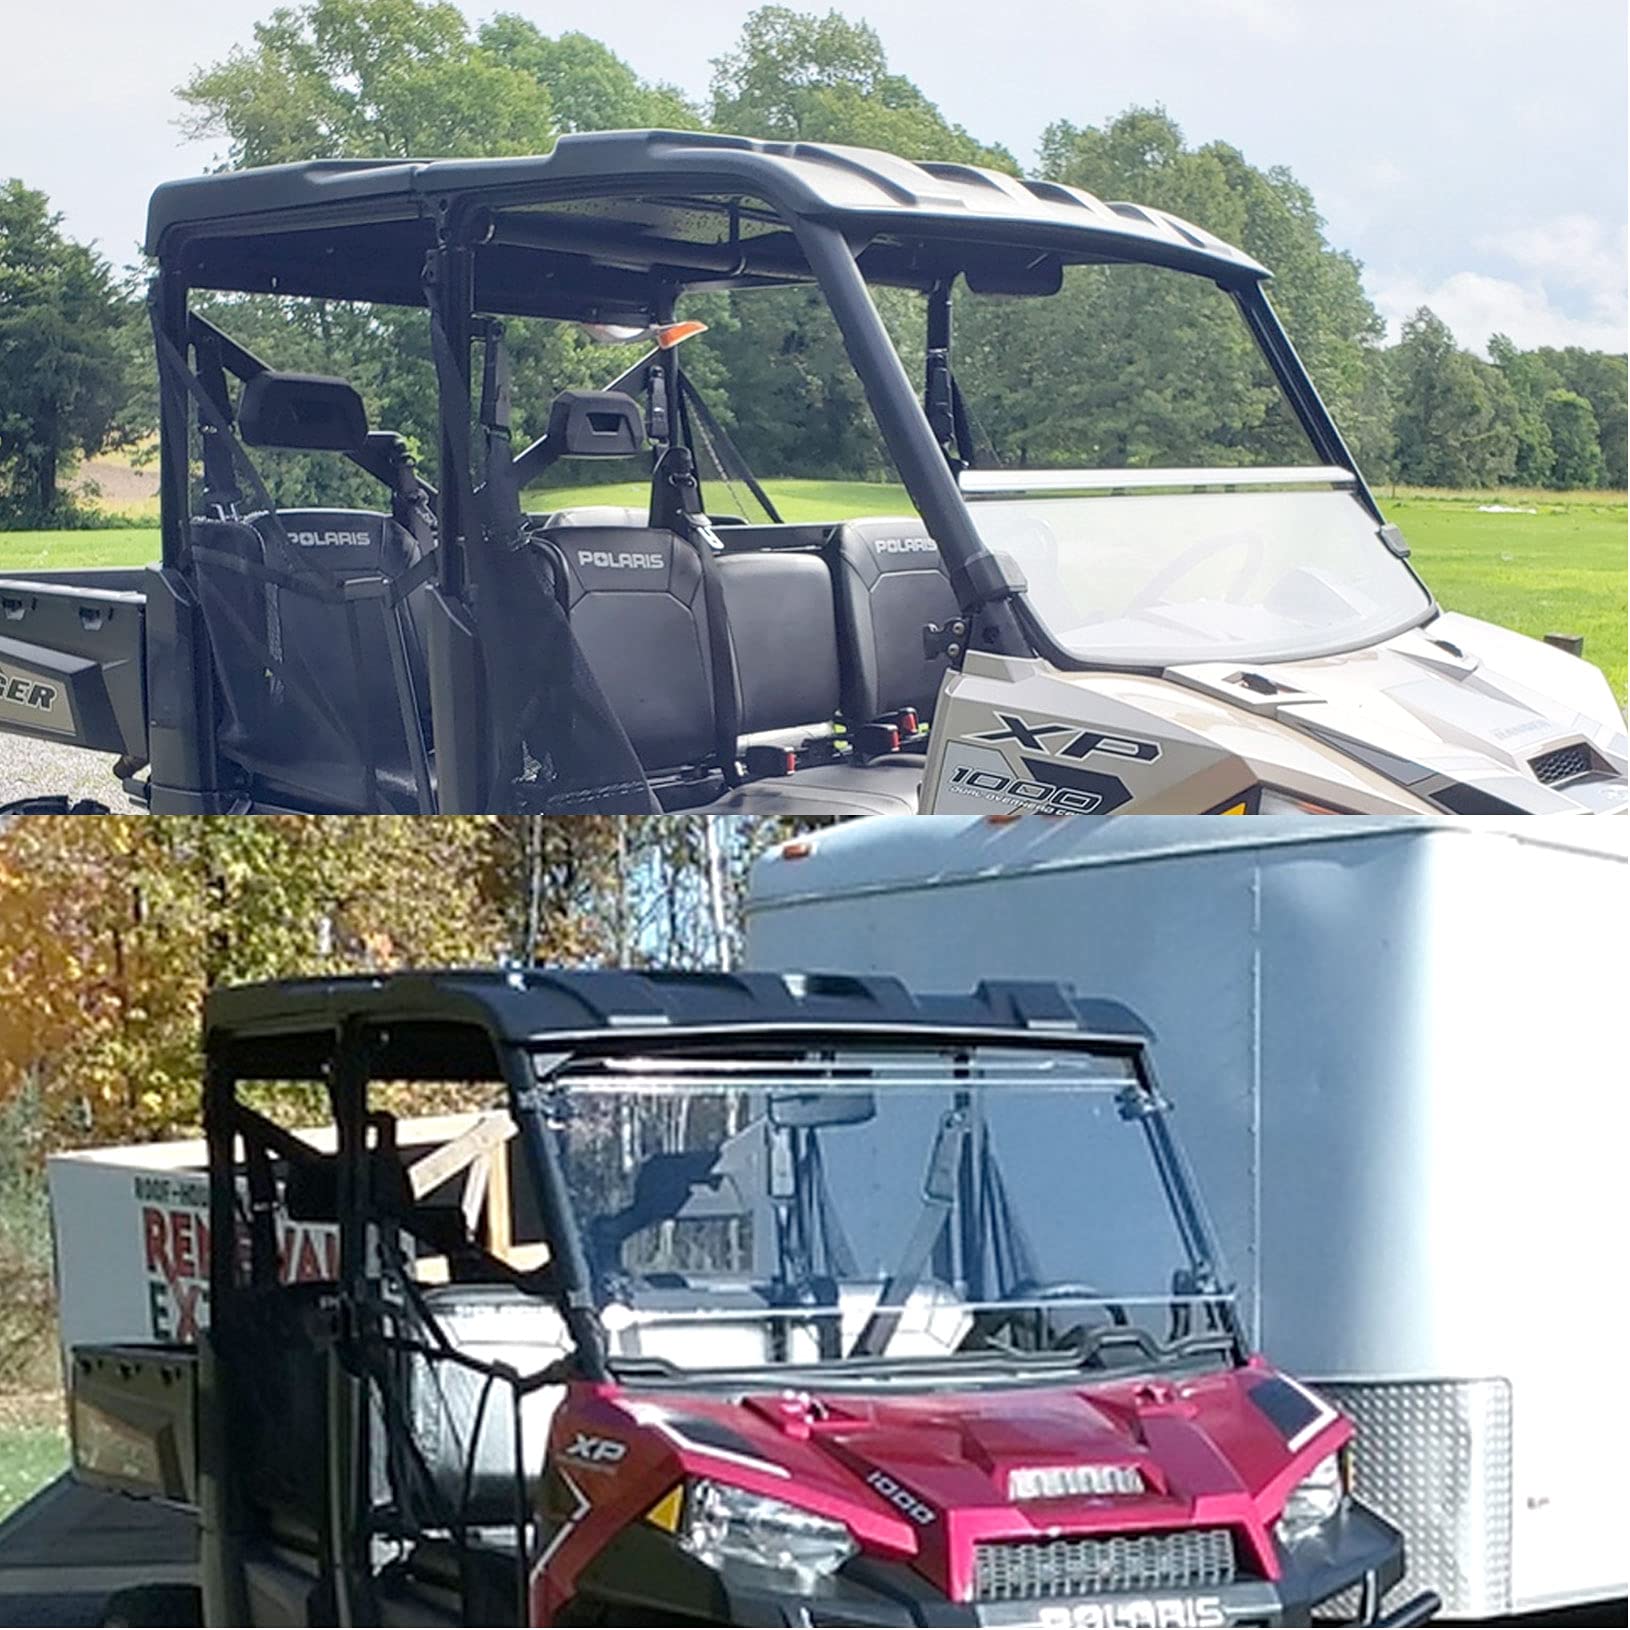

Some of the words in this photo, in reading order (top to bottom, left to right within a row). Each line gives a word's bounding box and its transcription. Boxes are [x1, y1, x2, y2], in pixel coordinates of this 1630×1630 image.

[577, 550, 664, 569] POLARIS
[874, 538, 938, 554] POLARIS
[960, 710, 1163, 765] XP
[950, 765, 1103, 814] 1000
[565, 1433, 626, 1460] XP
[866, 1470, 936, 1524] 1000
[1039, 1596, 1225, 1628] POLARIS
